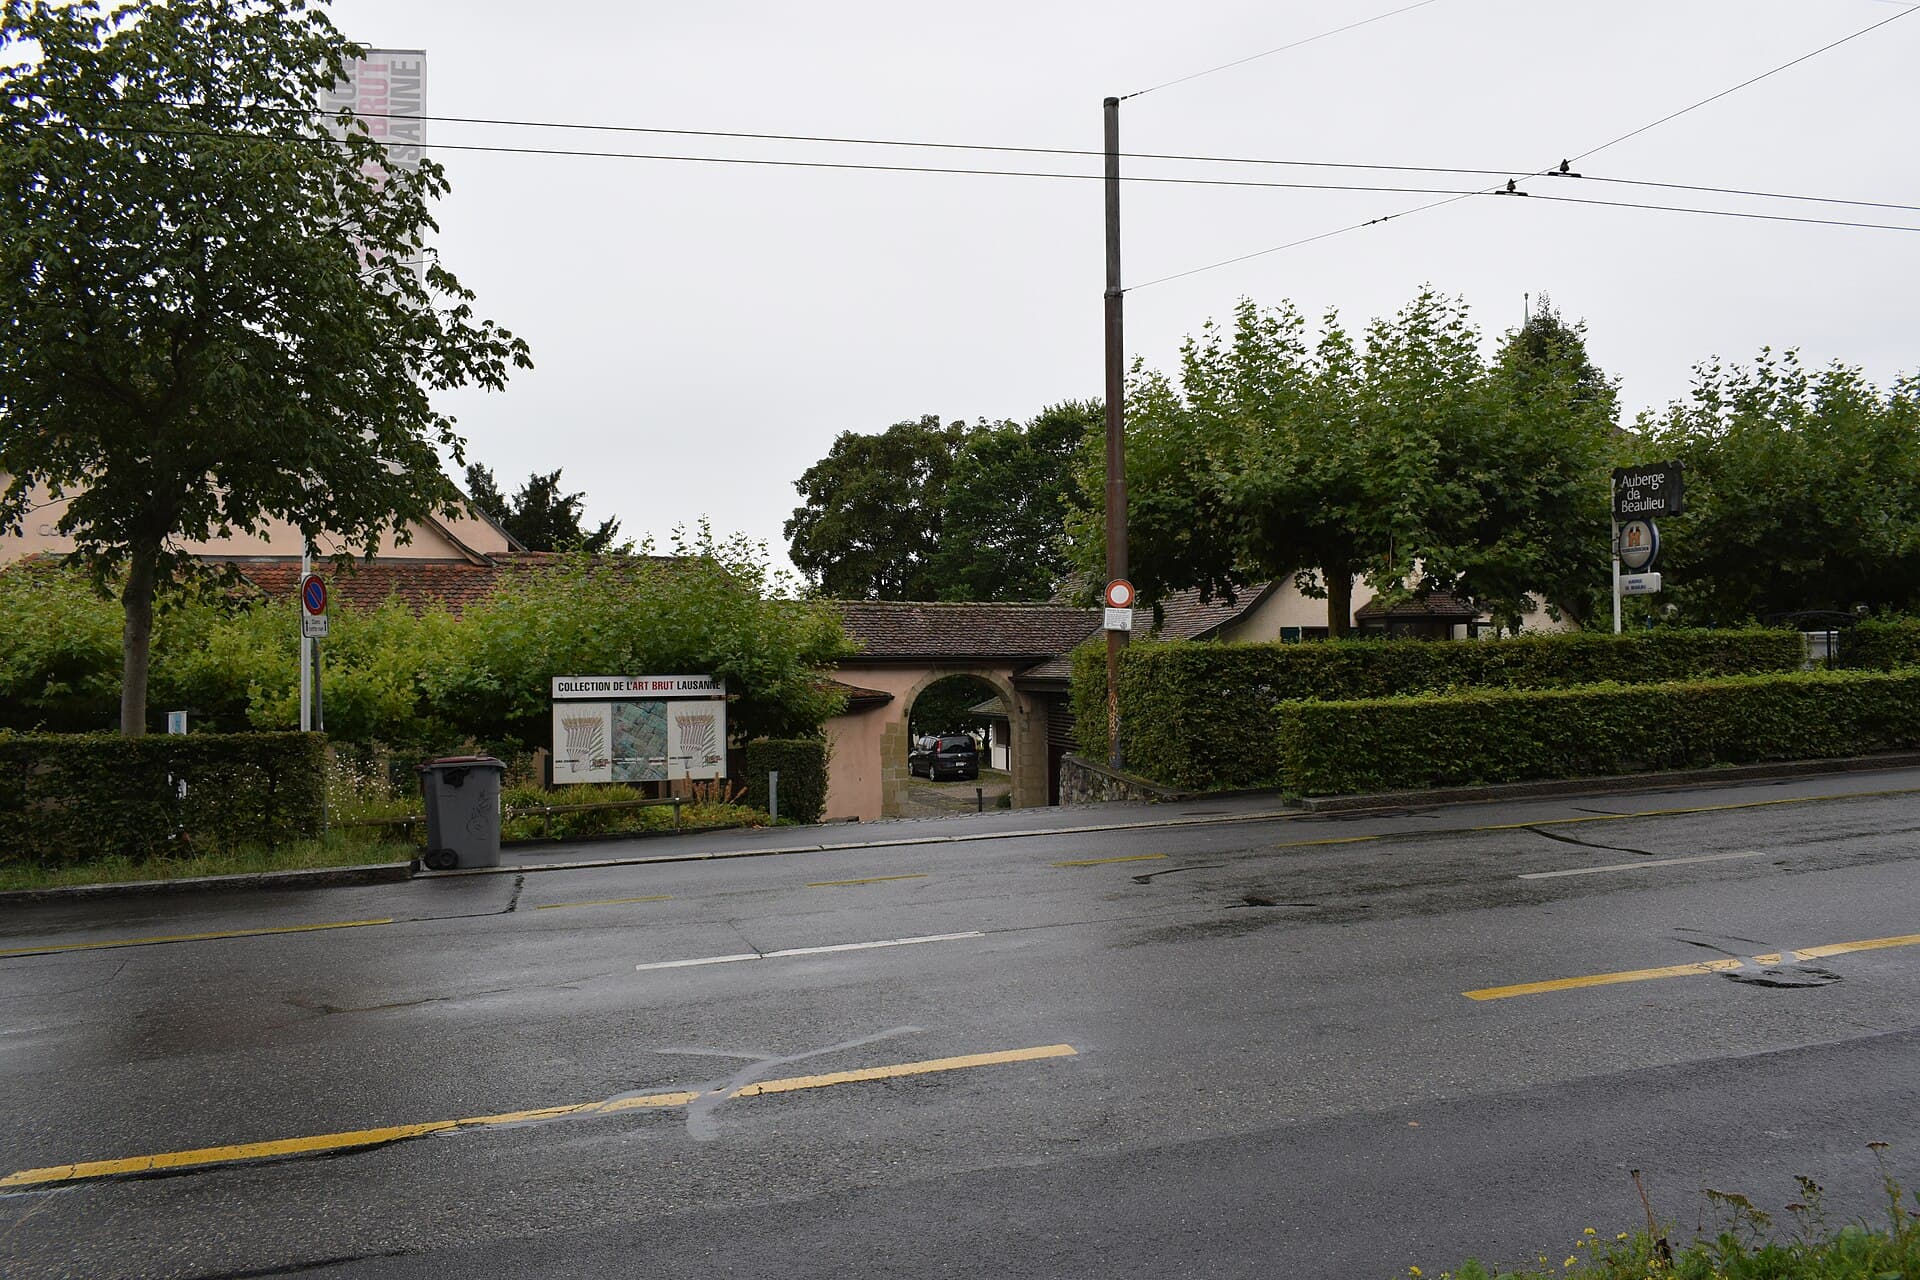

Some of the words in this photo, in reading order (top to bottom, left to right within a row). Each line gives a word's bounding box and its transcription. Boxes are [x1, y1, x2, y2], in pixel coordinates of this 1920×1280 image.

[358, 60, 388, 136] BRUT
[388, 60, 421, 182] SANNE
[1621, 472, 1665, 489] Auberge
[1626, 488, 1641, 500] de
[1621, 497, 1665, 513] Beaulieu
[558, 682, 611, 692] COLLECTION
[613, 681, 624, 691] DE
[626, 681, 649, 691] L'ART
[651, 681, 674, 690] BRUT
[677, 680, 721, 690] LAUSANNE
